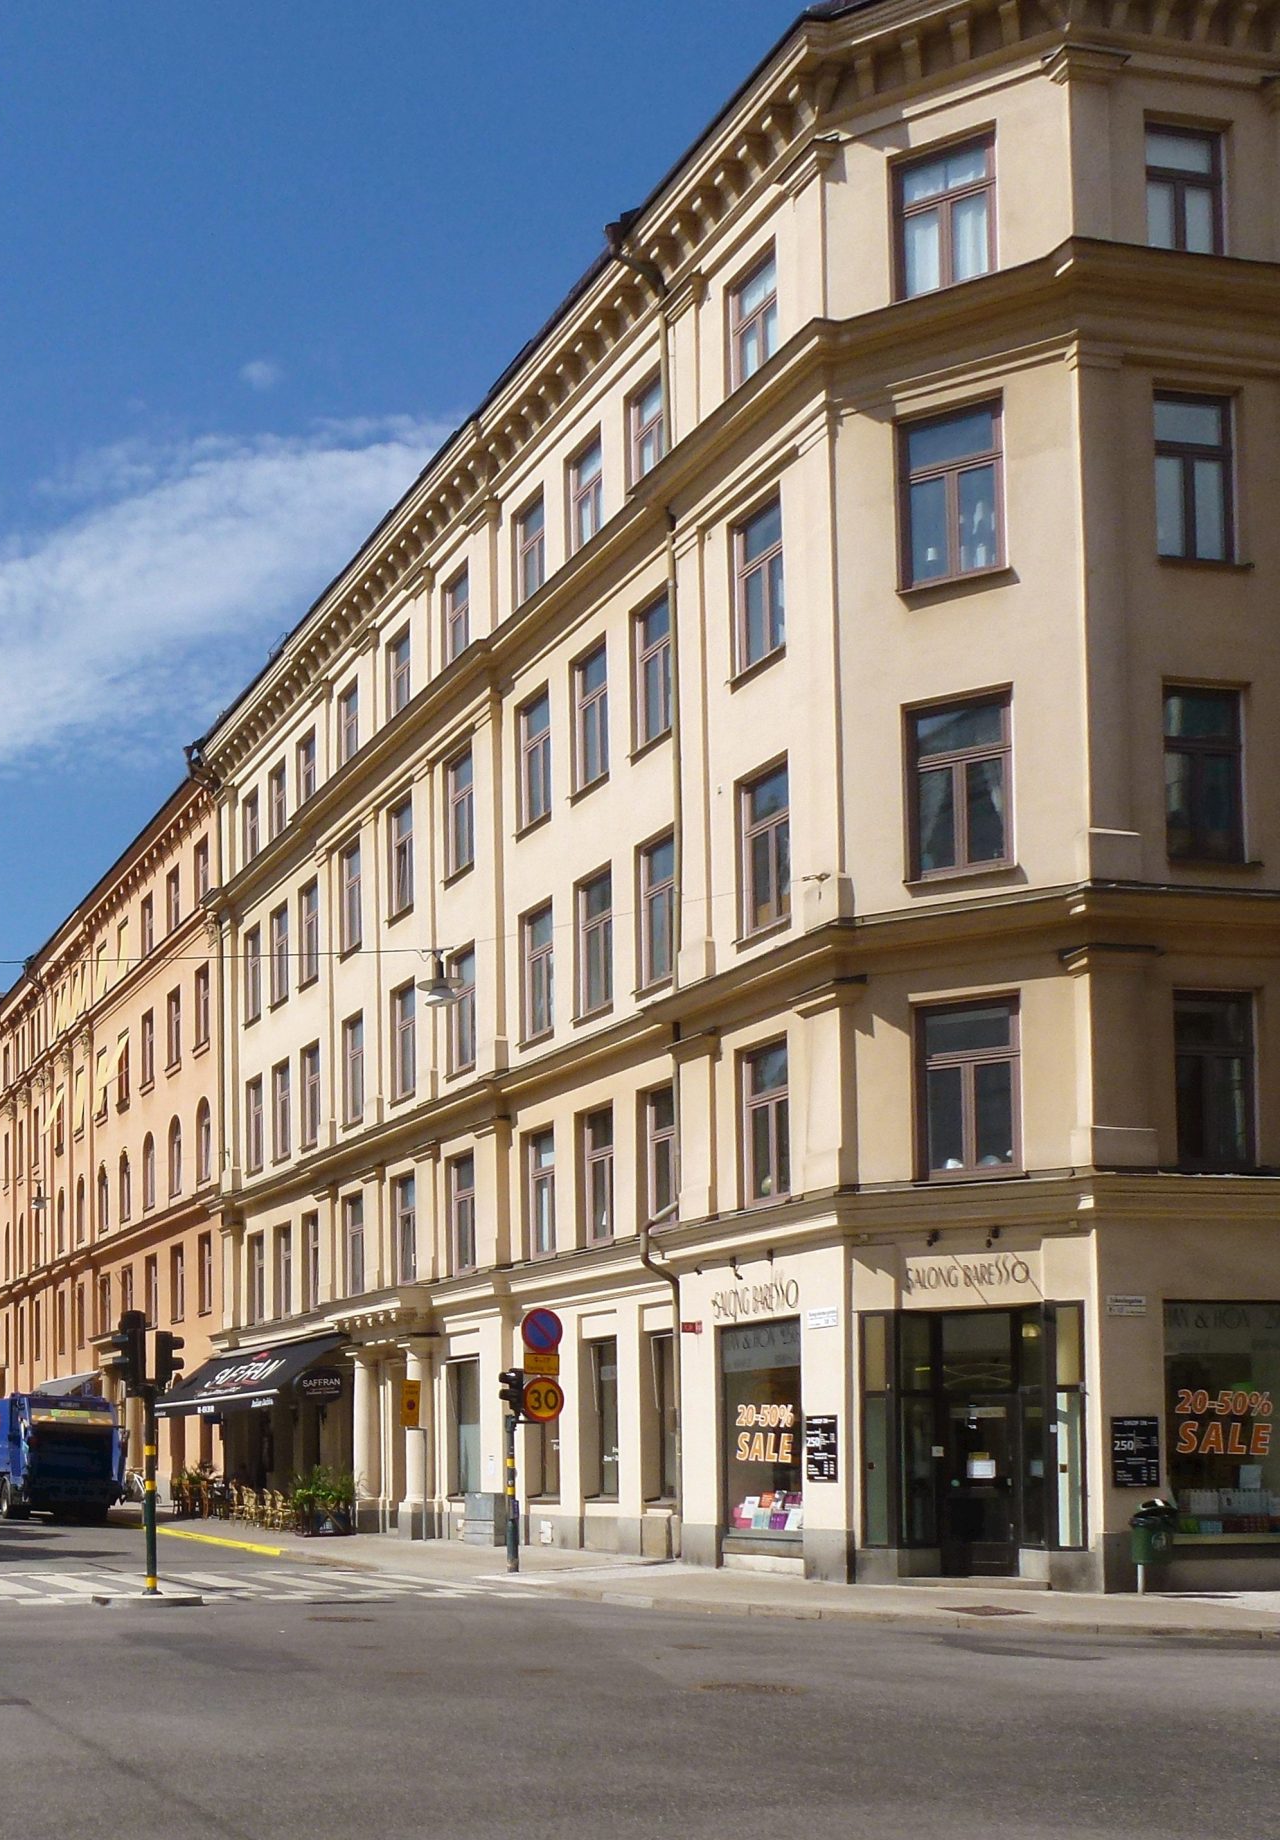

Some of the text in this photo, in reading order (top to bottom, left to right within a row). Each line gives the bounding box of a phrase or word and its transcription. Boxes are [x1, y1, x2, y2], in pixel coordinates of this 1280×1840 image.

[905, 1255, 1030, 1290] SALONG BARESSO
[711, 1275, 799, 1319] SALONG BARESSO
[302, 1377, 341, 1388] SAFFRAN
[530, 1389, 559, 1411] 30
[1175, 1389, 1273, 1416] 20-50%
[735, 1404, 795, 1428] 20-50%
[736, 1431, 794, 1463] SALE
[1114, 1440, 1134, 1451] 250
[1176, 1420, 1272, 1455] SALE
